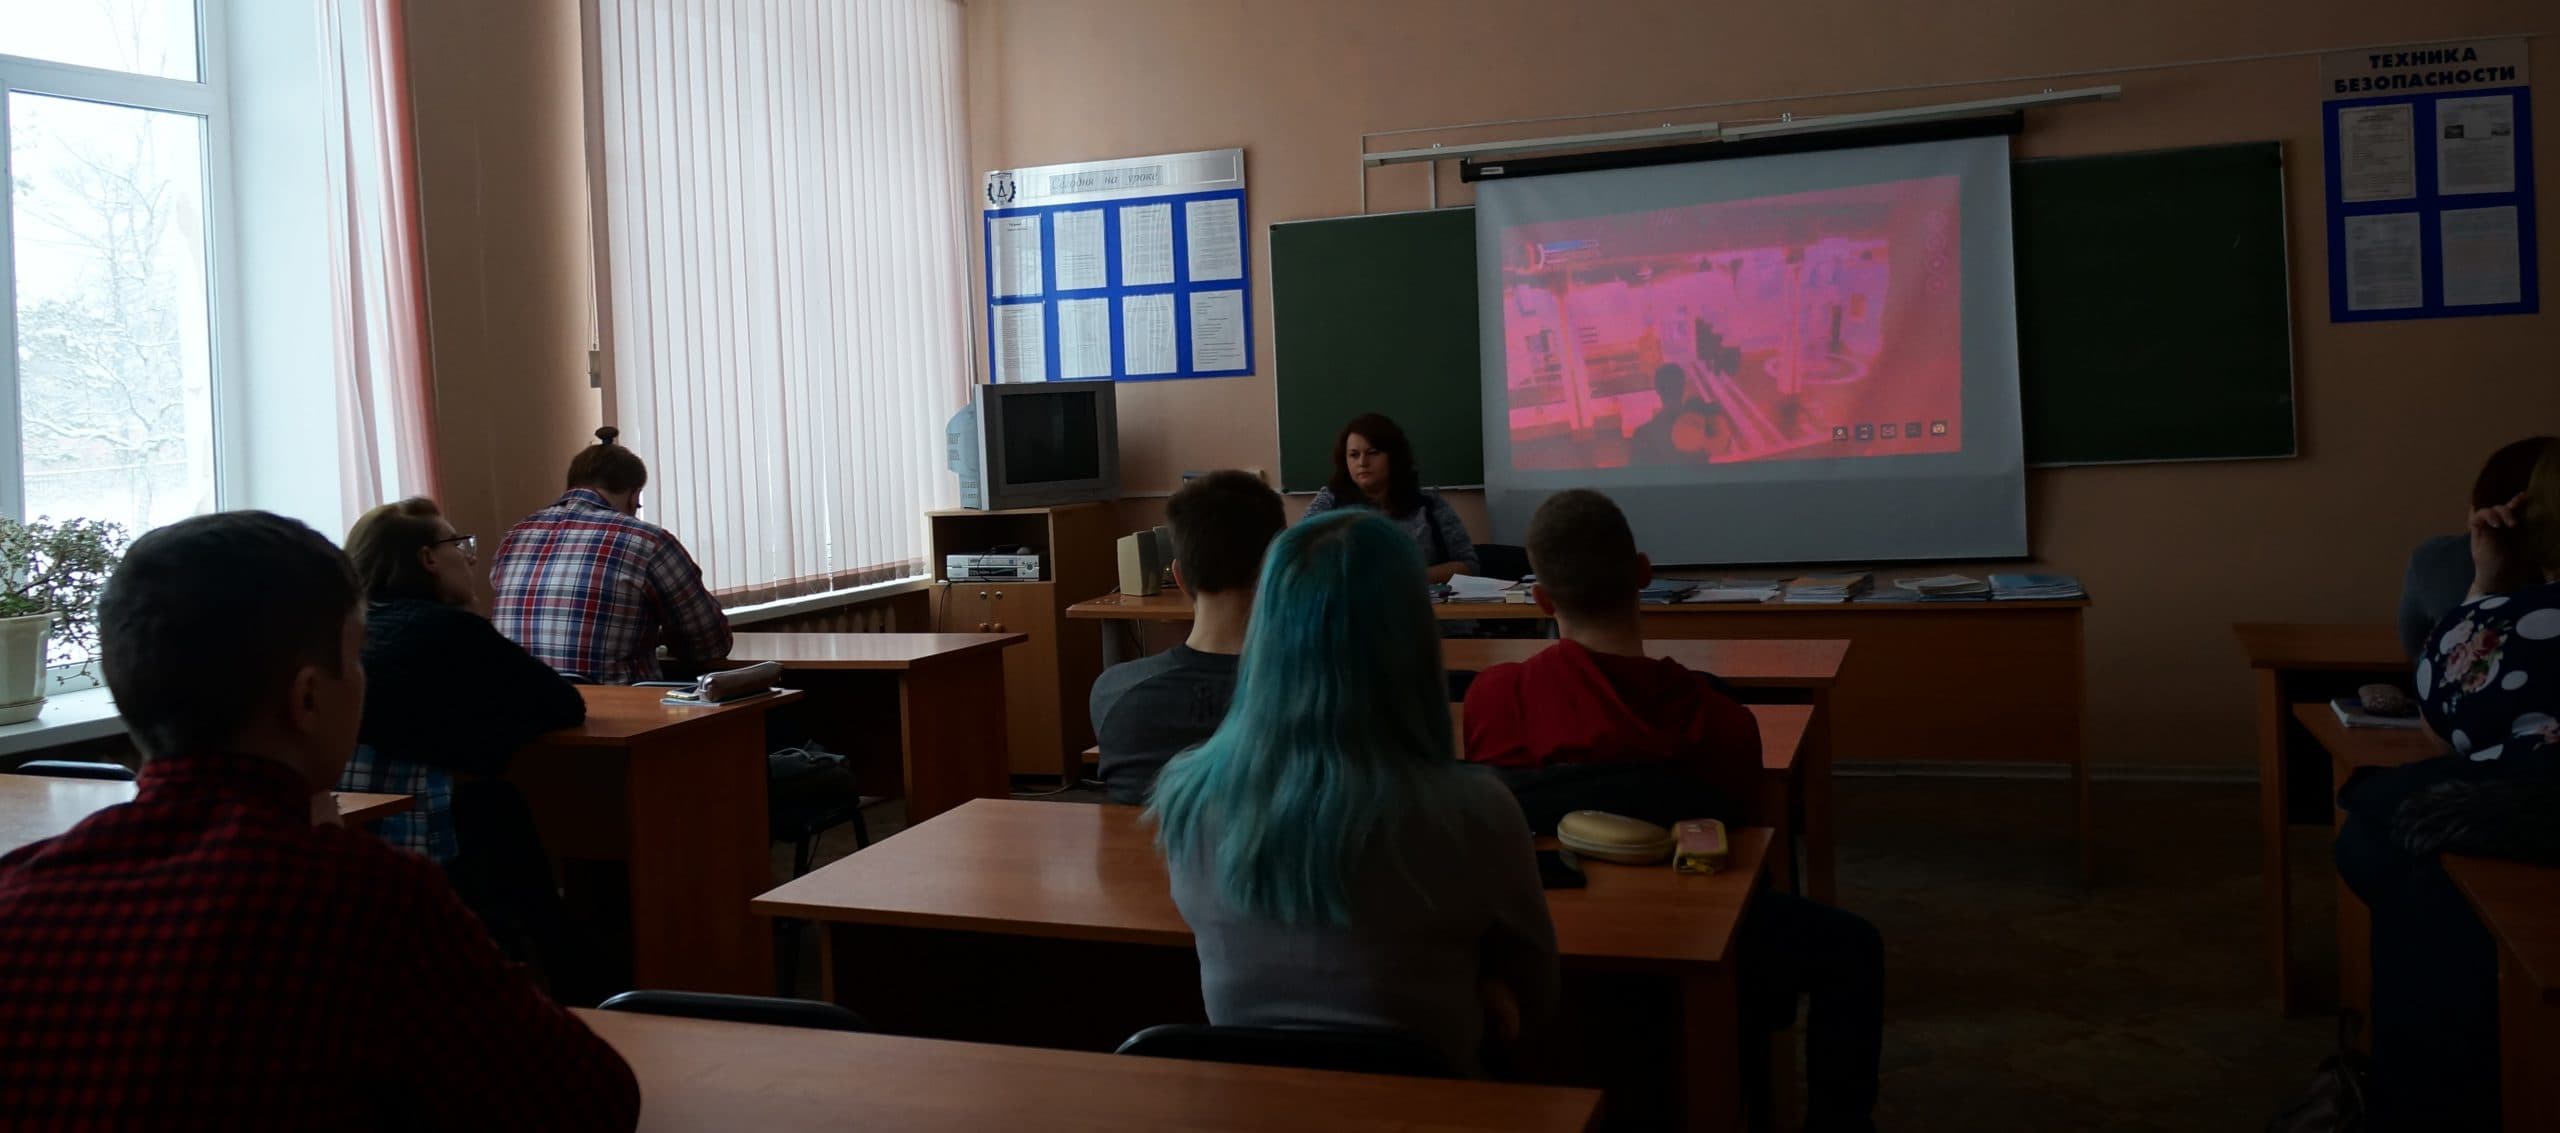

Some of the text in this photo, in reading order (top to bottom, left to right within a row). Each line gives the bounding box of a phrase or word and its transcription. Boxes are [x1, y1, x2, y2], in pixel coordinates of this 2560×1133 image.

[2368, 46, 2478, 69] ТЕХНИКА
[2334, 65, 2516, 94] БЕЗОПАСНОСТИ
[1051, 176, 1095, 190] Сеодня
[1104, 176, 1118, 185] на
